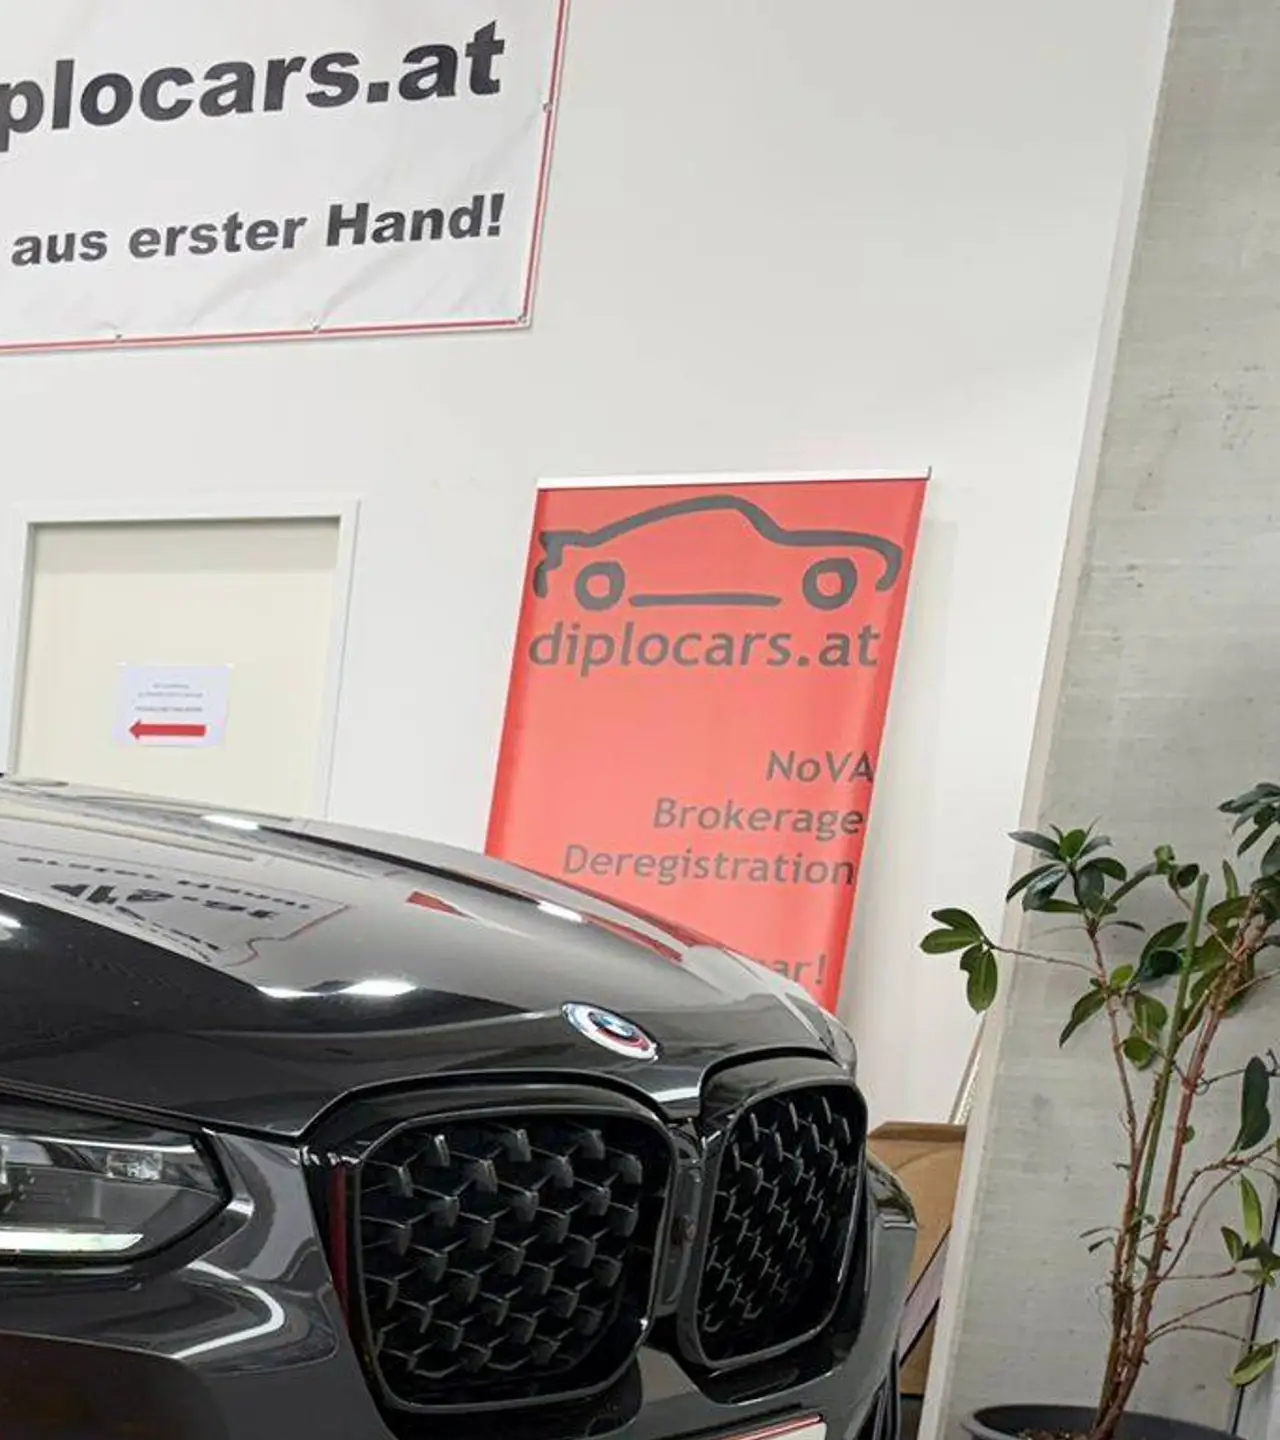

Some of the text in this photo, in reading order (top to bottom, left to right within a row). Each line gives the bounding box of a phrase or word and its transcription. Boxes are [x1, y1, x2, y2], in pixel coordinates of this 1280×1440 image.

[10, 230, 108, 267] aus
[127, 211, 307, 259] erster
[325, 192, 506, 248] Hand!
[527, 620, 881, 677] diplocars.at
[765, 750, 875, 784] NoVA
[652, 797, 865, 841] Brokerage
[561, 843, 856, 886] Deregistration
